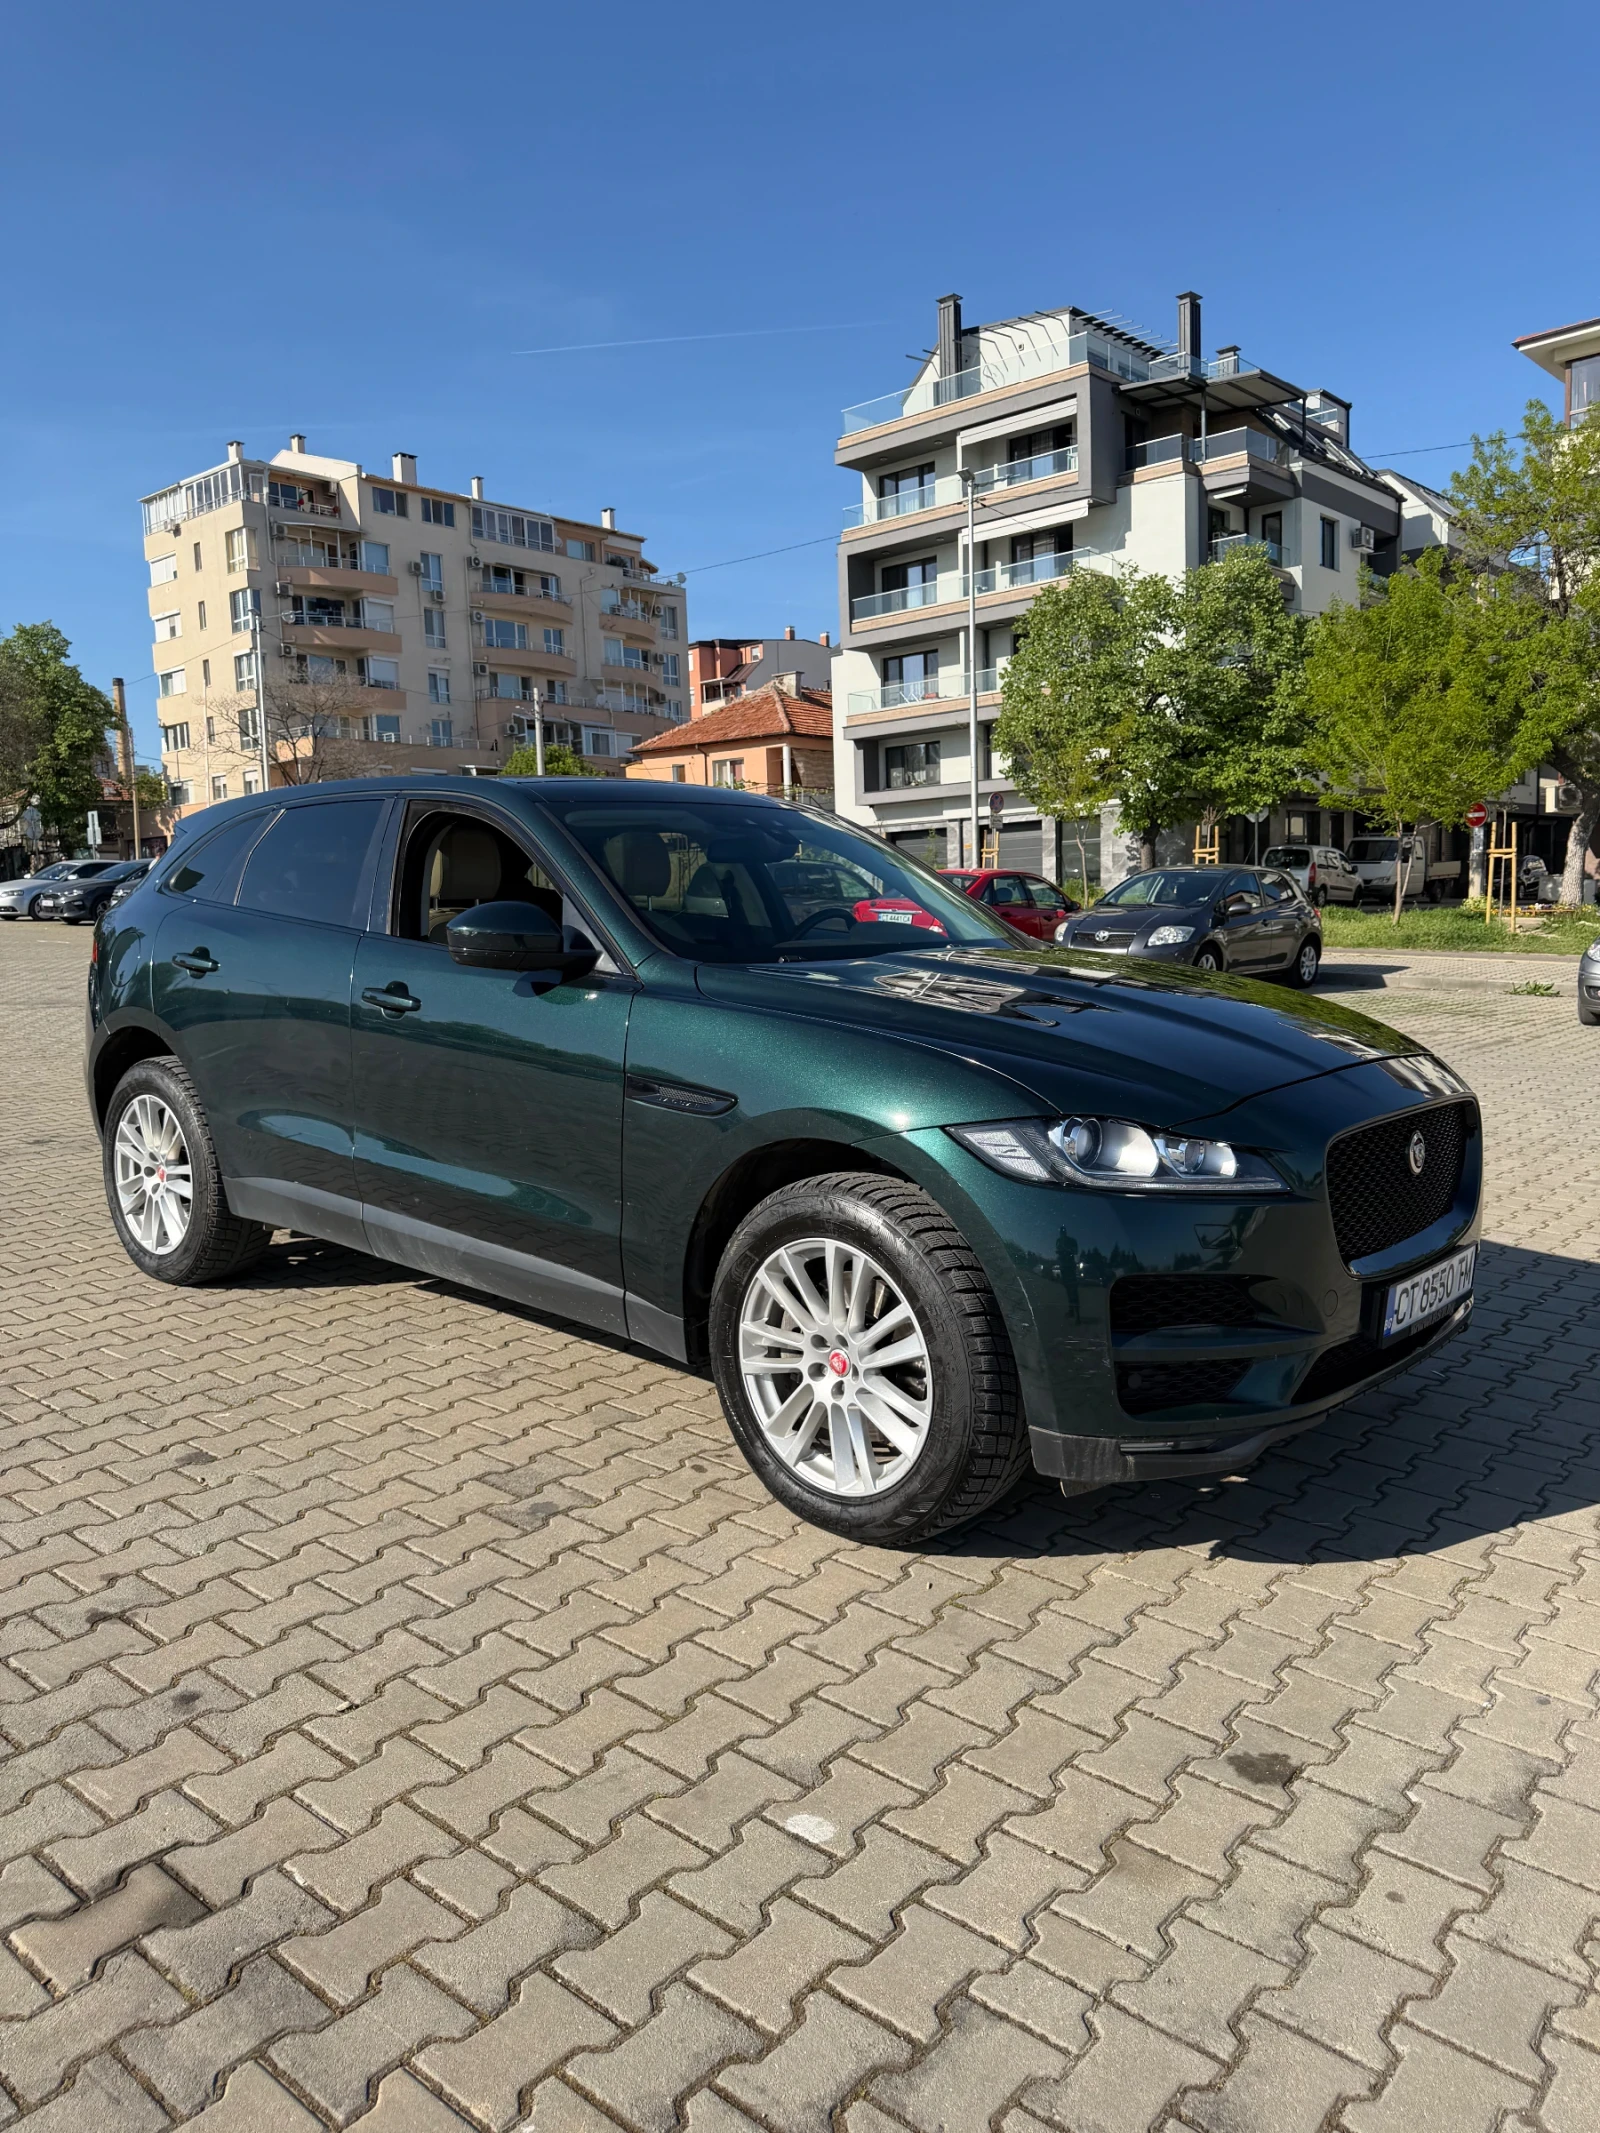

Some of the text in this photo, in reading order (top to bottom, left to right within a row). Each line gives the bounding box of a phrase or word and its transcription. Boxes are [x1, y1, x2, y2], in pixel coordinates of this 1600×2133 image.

[1395, 1282, 1419, 1325] CT
[1420, 1263, 1455, 1313] 8550
[1457, 1251, 1474, 1292] TM
